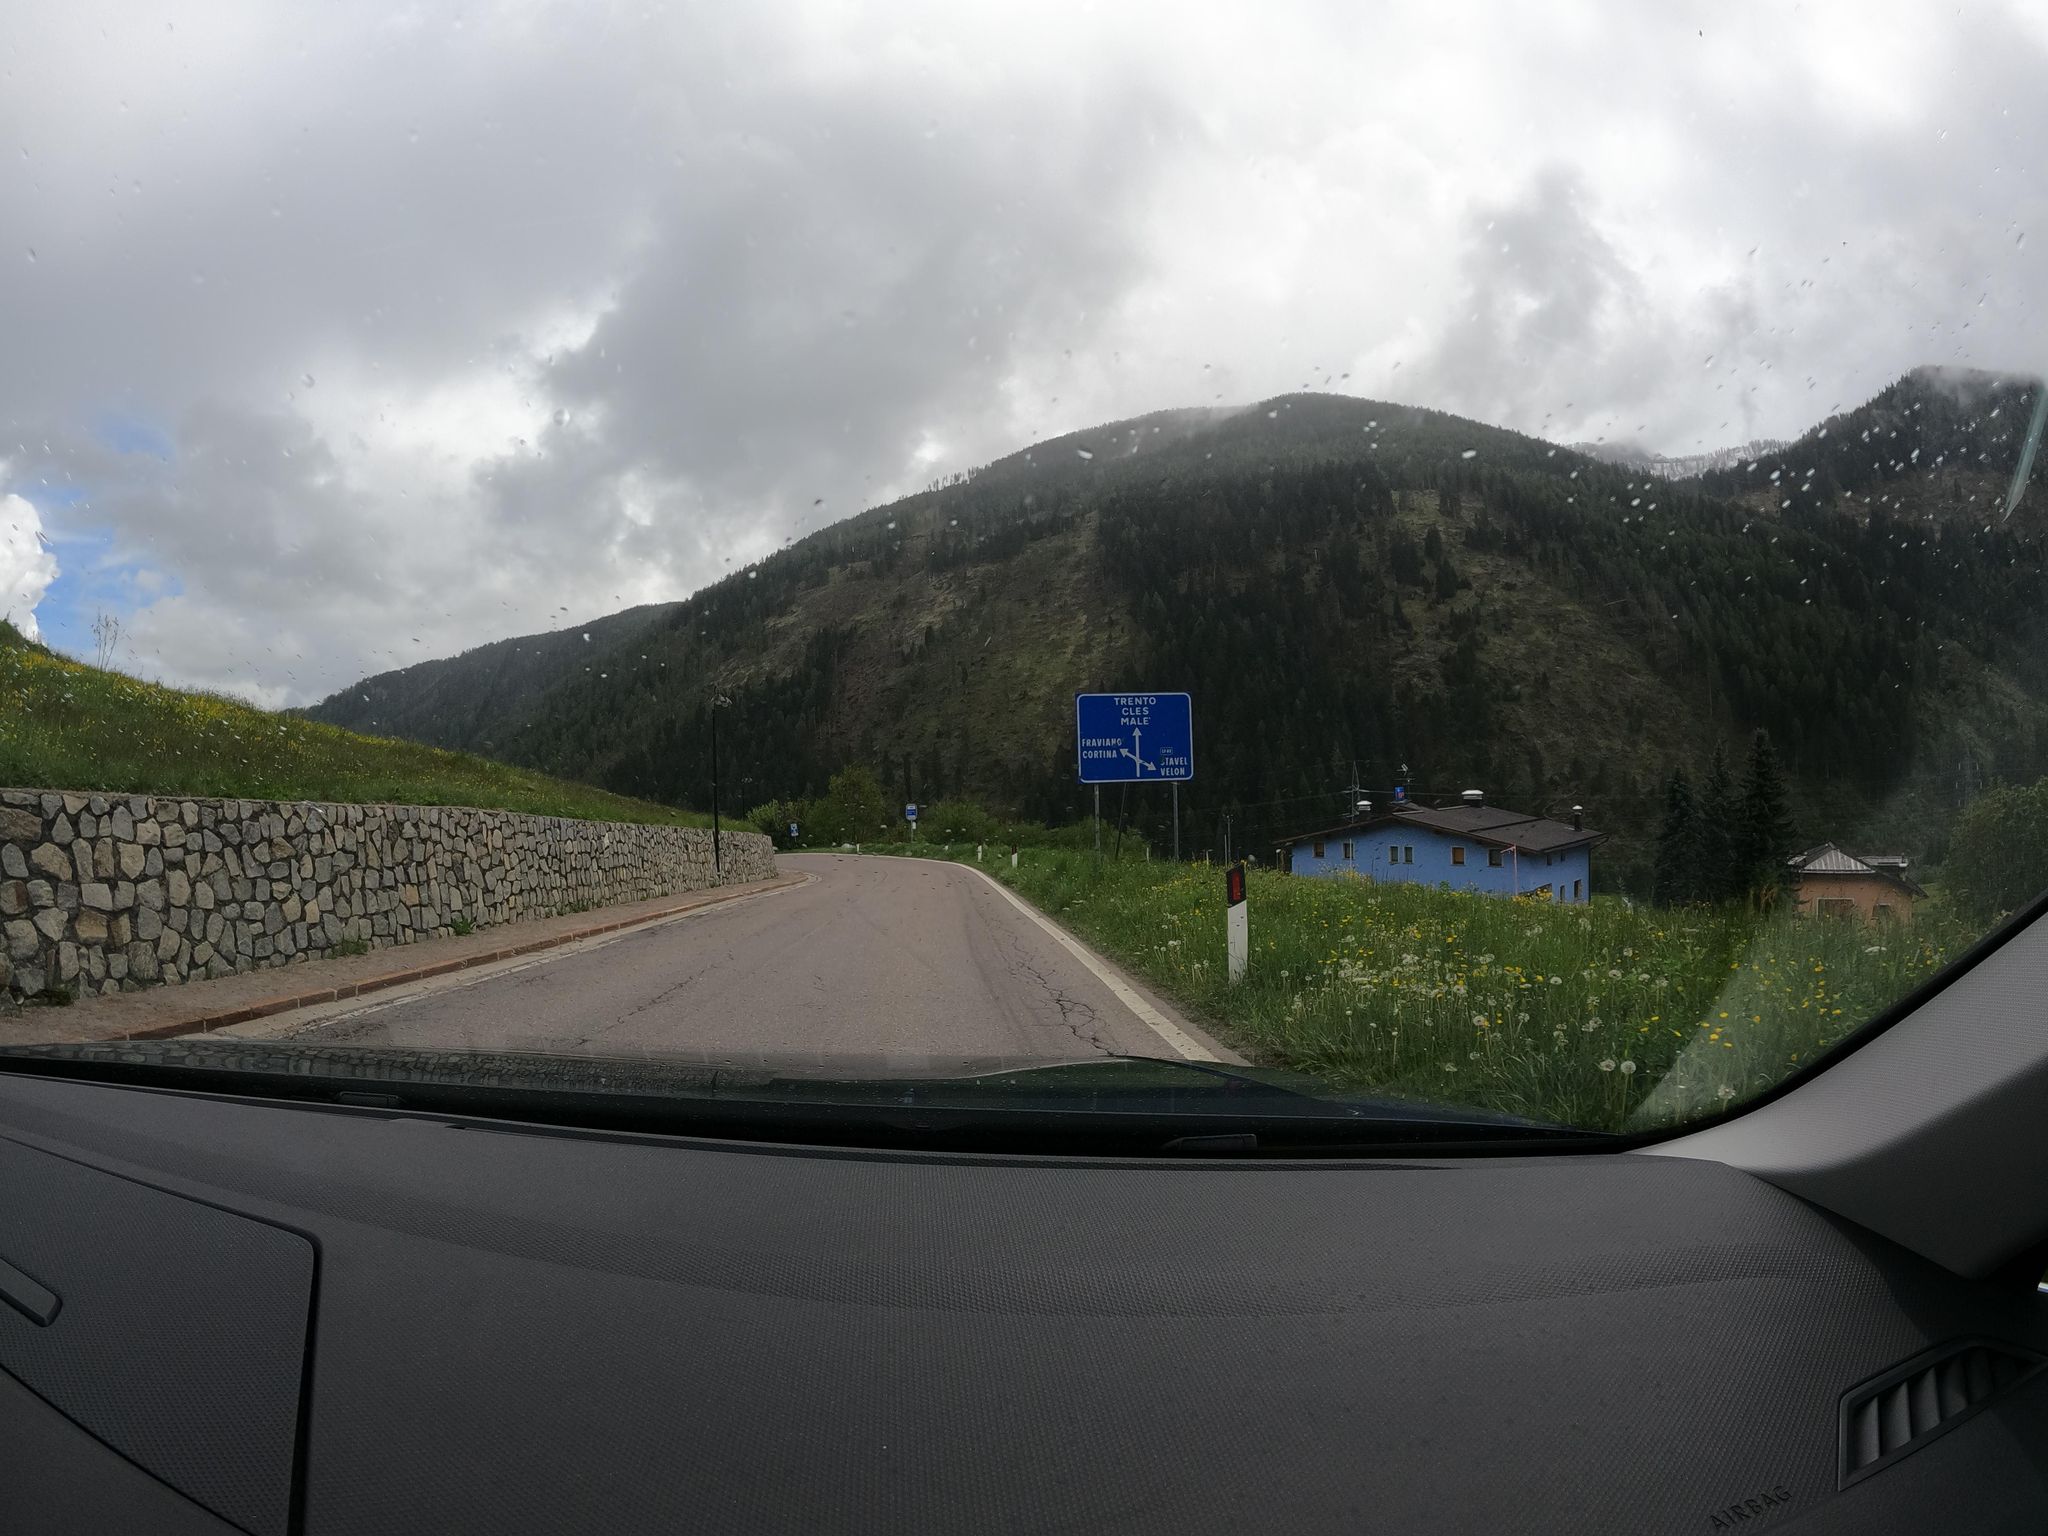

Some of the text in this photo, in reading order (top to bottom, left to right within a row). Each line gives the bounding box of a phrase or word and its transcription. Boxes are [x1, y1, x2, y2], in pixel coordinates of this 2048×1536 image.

[1114, 697, 1156, 705] TRENTO
[1122, 707, 1149, 715] CLES
[1082, 738, 1122, 747] FRAVIANO
[1082, 750, 1117, 758] CORTINA
[1161, 767, 1185, 775] VELON
[1711, 1486, 1792, 1529] AIRBAG
